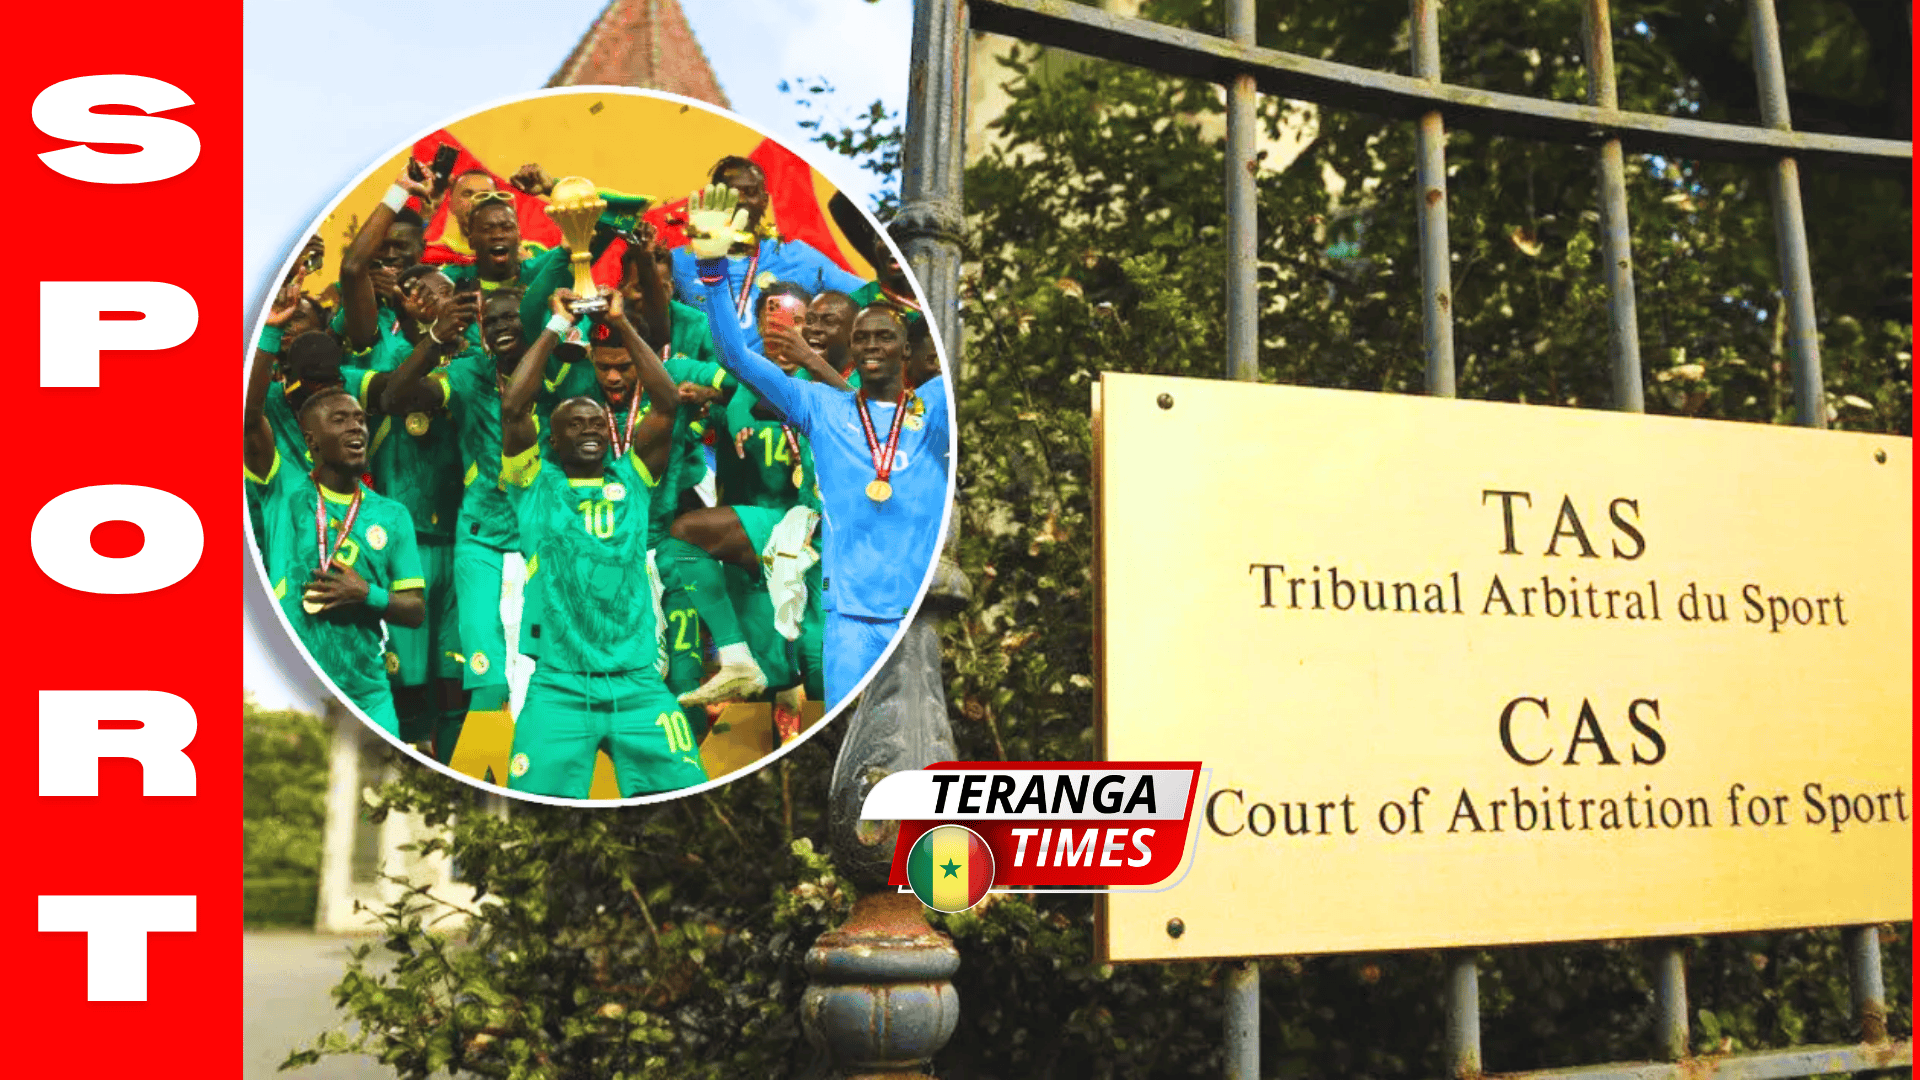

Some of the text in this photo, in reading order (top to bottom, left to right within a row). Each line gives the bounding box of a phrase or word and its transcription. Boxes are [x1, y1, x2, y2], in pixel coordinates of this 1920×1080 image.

[578, 500, 614, 539] 10
[1483, 490, 1646, 560] TAS
[1249, 564, 1848, 633] Tribunal Arbitral du Sport
[655, 711, 693, 753] 10
[1499, 697, 1667, 766] CAS
[1206, 782, 1910, 838] Court of Arbitration for Sport
